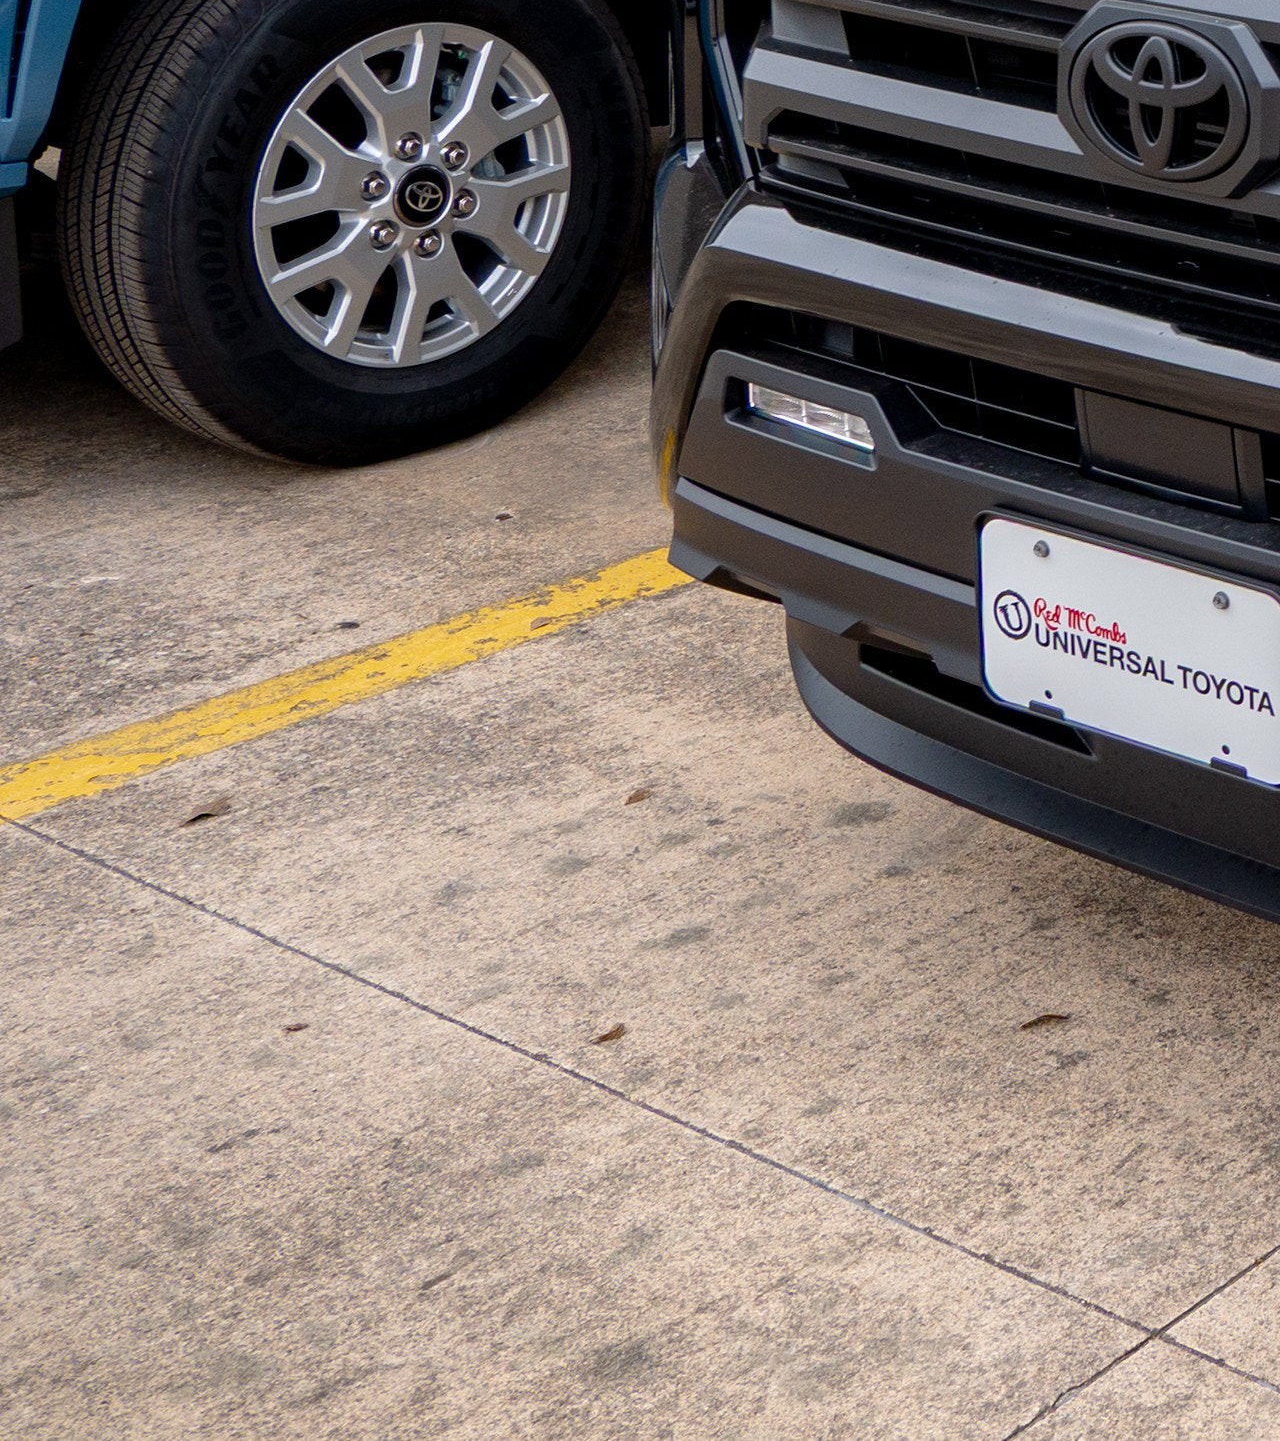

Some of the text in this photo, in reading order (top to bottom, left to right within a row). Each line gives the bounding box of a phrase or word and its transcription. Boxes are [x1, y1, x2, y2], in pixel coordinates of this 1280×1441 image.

[1034, 597, 1127, 645] Red McCombs
[1035, 623, 1275, 717] UNIVERSAL TOYOTA
